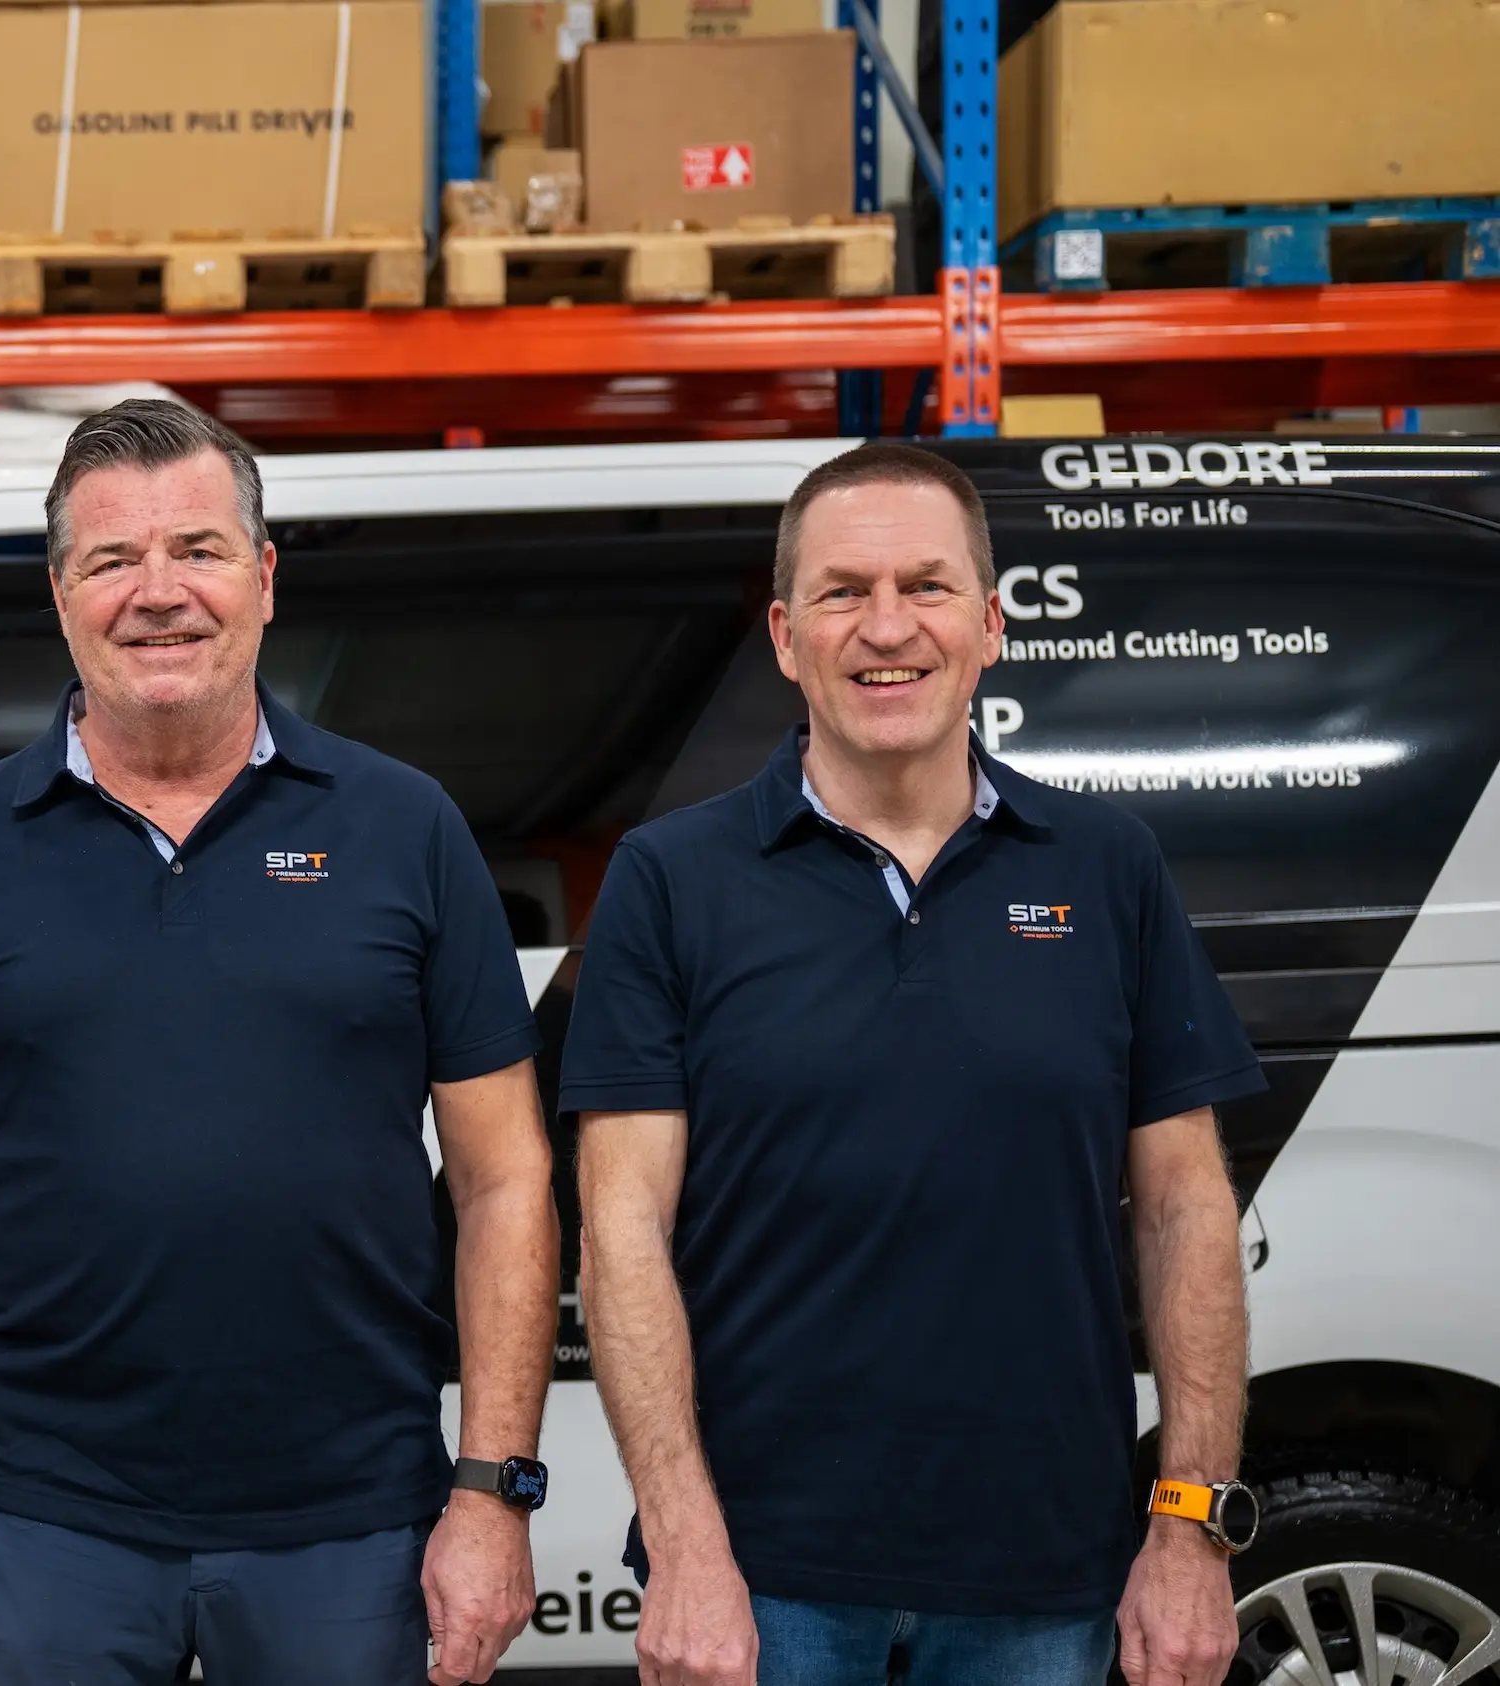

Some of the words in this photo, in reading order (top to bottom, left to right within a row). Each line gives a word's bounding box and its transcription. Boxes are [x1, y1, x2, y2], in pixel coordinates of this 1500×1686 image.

[185, 110, 240, 133] PILE
[1041, 441, 1332, 491] GEDORE
[1045, 501, 1126, 530] Tools
[1134, 501, 1183, 528] For
[1192, 498, 1248, 526] Life
[998, 564, 1083, 620] CS
[1001, 631, 1116, 662] iamond
[1124, 629, 1239, 662] Cutting
[1246, 626, 1329, 655] Tools
[1280, 763, 1361, 788] Tools
[266, 852, 327, 869] SPT
[1008, 904, 1071, 923] SPT
[531, 1570, 642, 1636] eie
